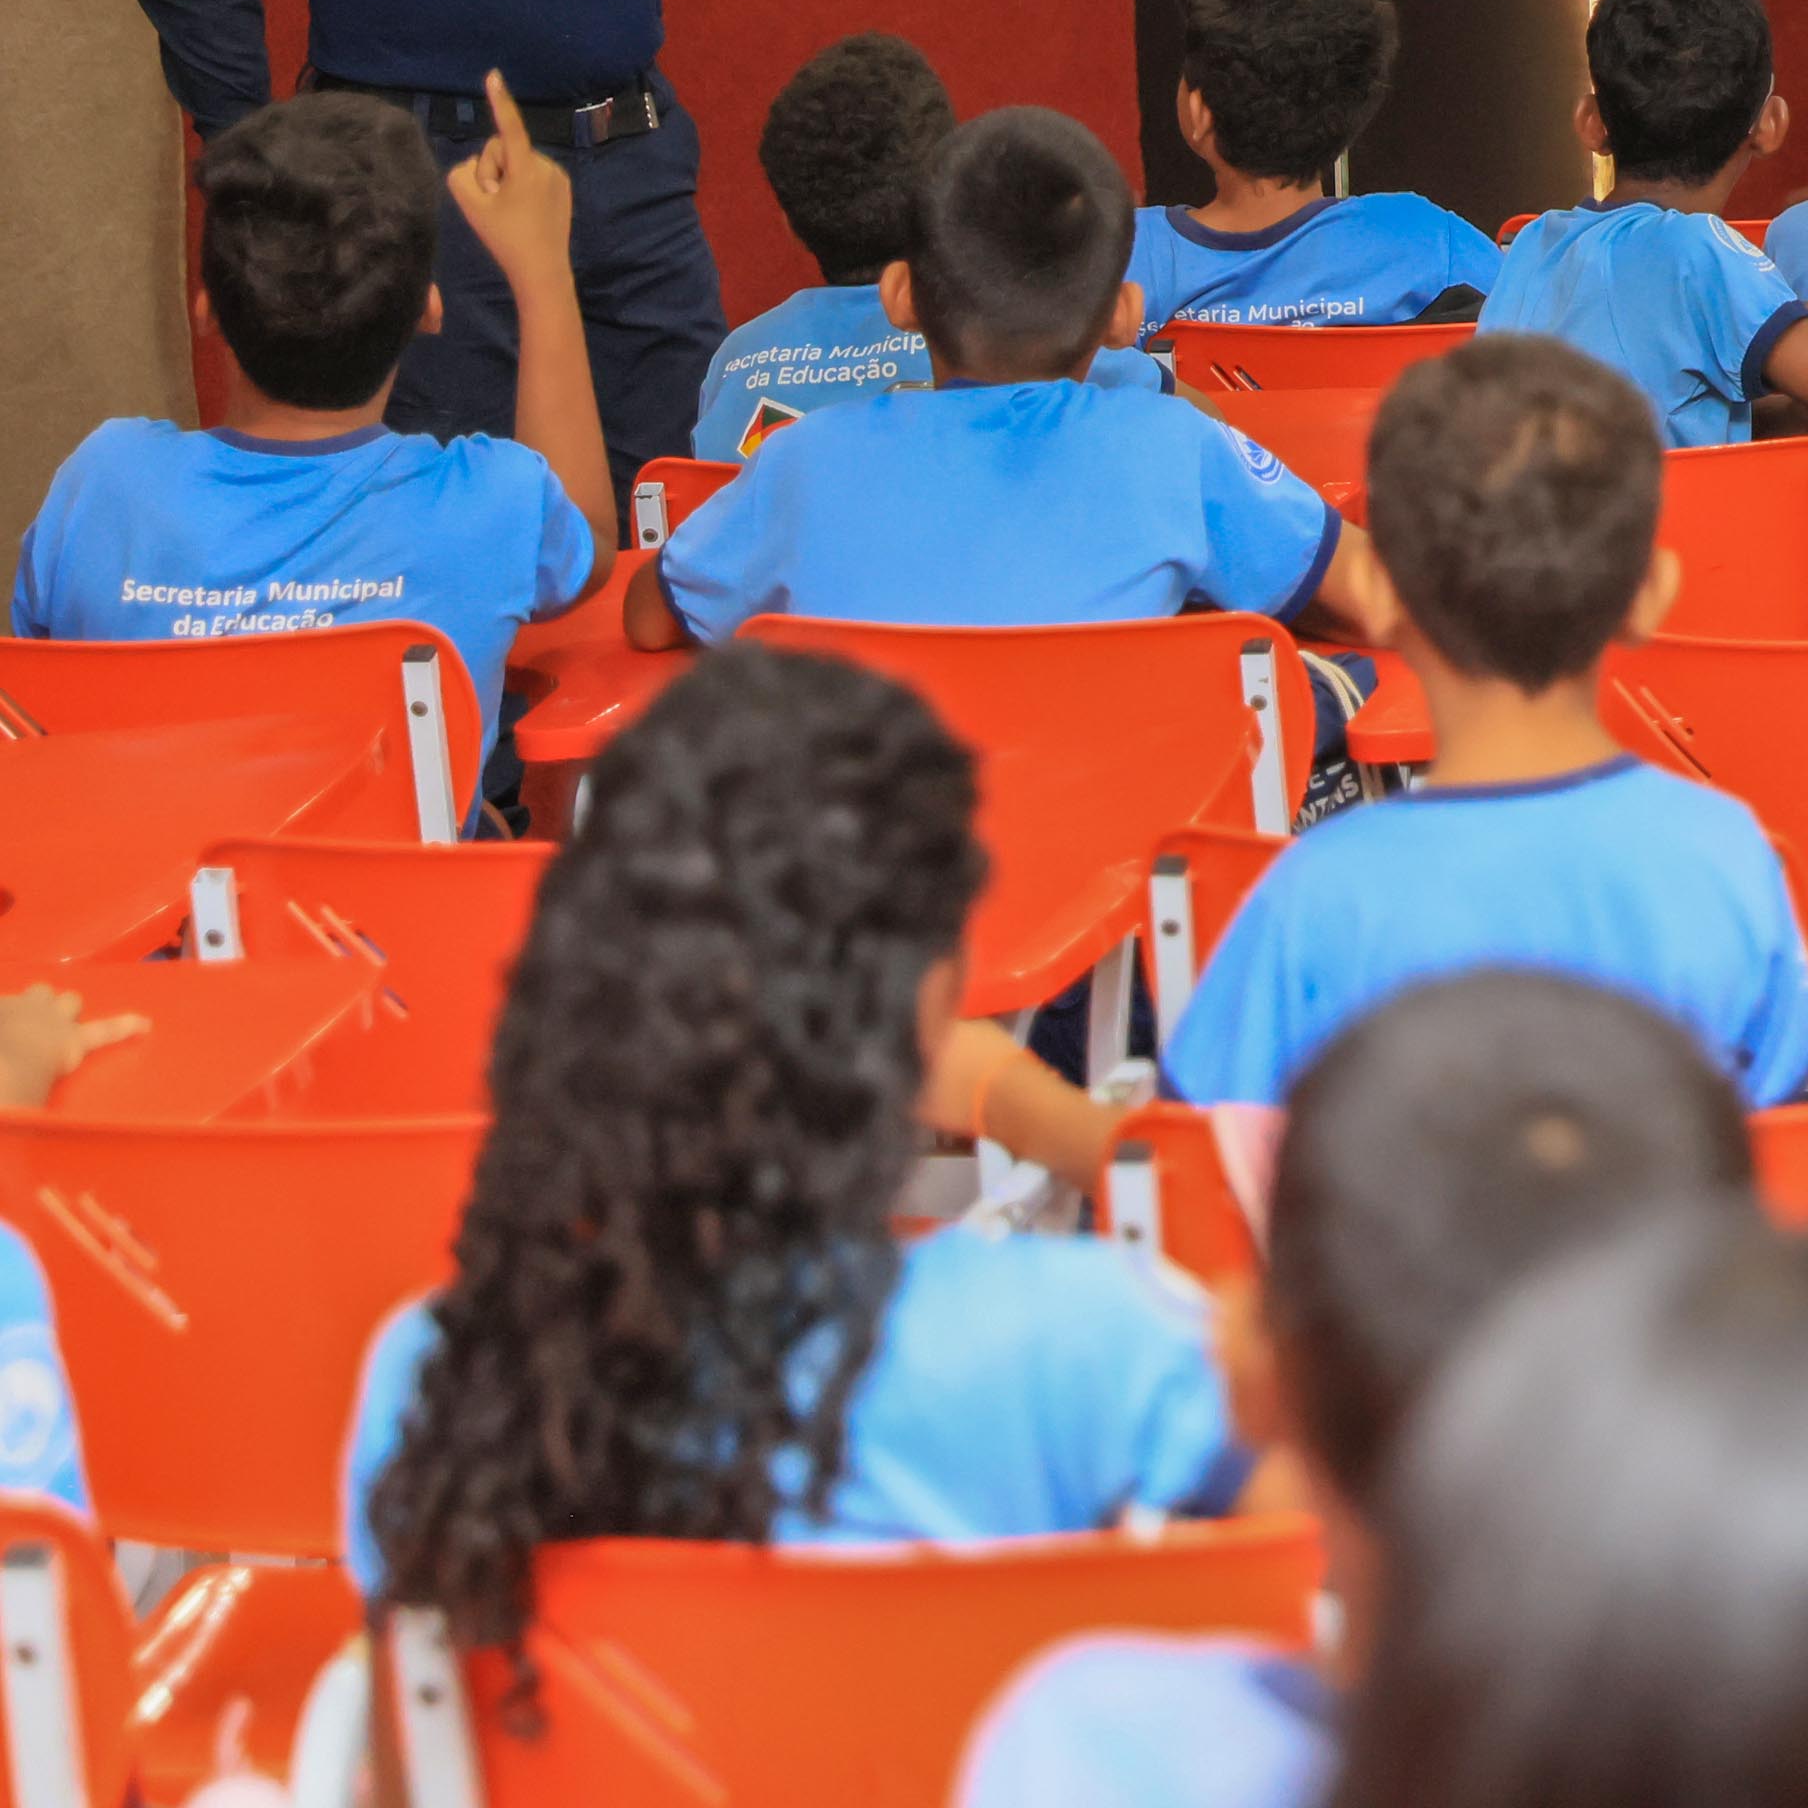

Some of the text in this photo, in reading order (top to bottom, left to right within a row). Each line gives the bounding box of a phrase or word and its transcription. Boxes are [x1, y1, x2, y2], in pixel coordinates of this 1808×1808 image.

[1249, 297, 1365, 323] Municipal
[828, 331, 926, 360] Municip
[745, 358, 897, 389] da Educação
[121, 576, 404, 607] Secretaria Municipal
[173, 614, 206, 636] da
